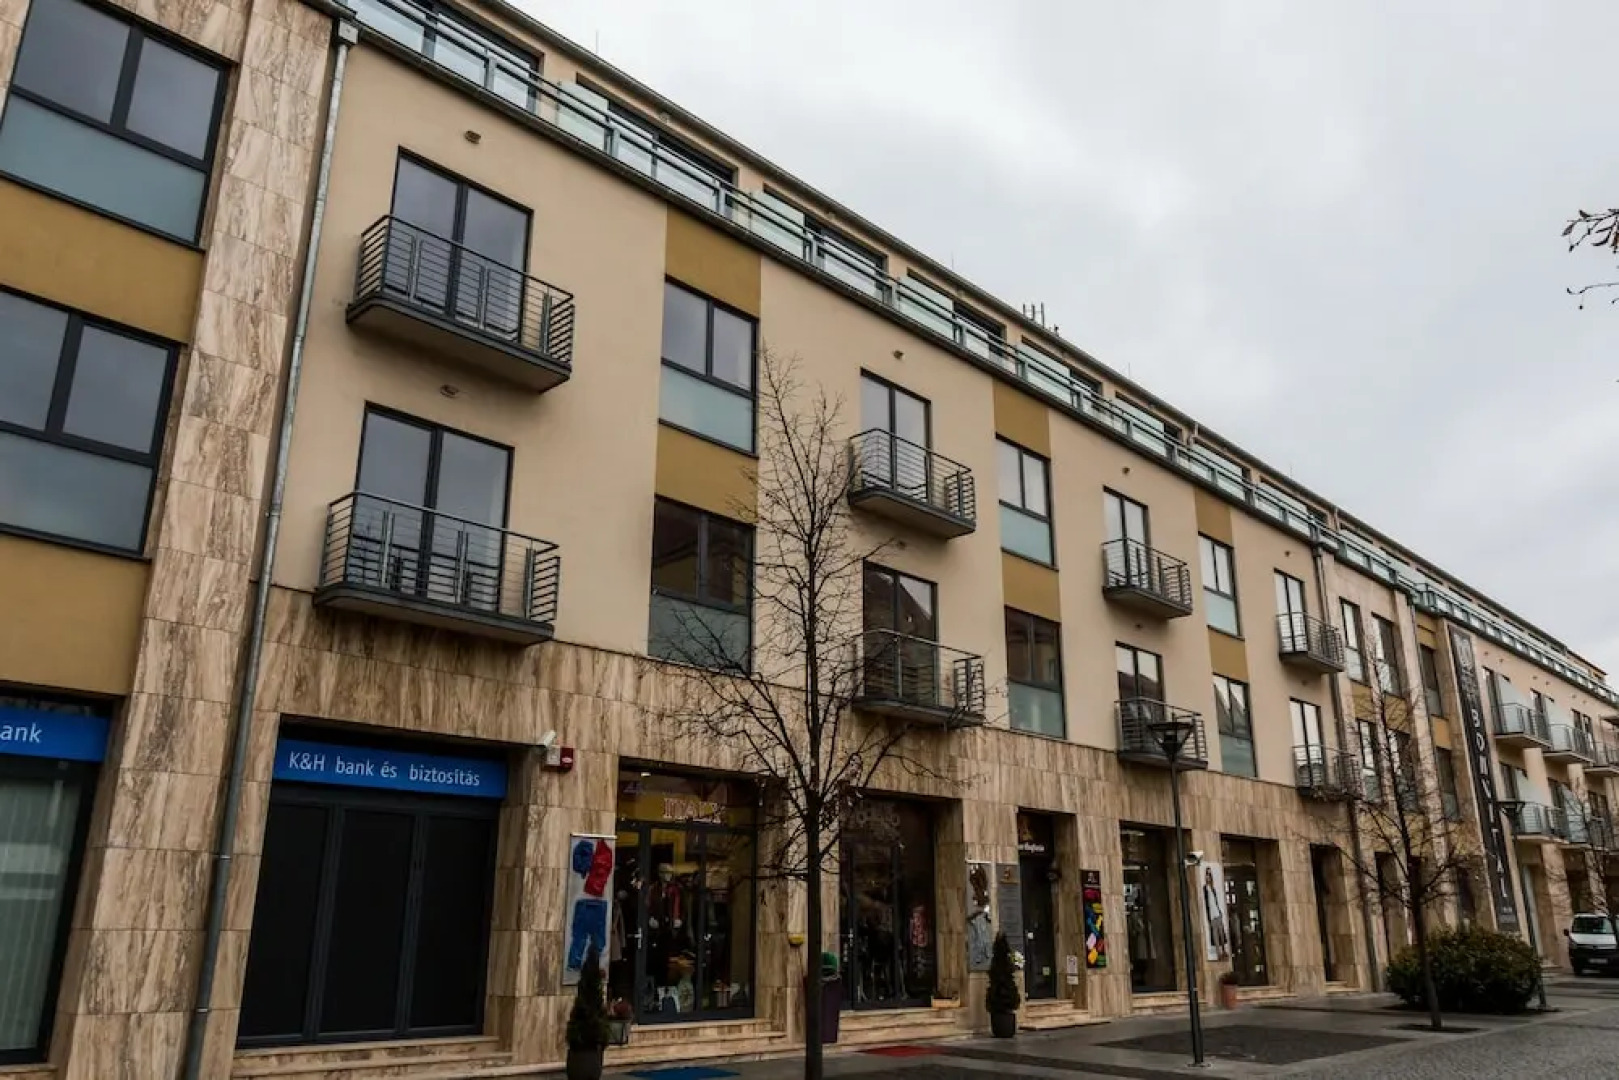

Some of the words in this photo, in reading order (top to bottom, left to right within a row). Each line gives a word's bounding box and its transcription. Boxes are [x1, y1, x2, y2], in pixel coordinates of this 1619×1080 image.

[289, 752, 325, 772] K&H
[336, 757, 375, 777] bank
[381, 761, 398, 778] és
[410, 763, 480, 786] biztosítás
